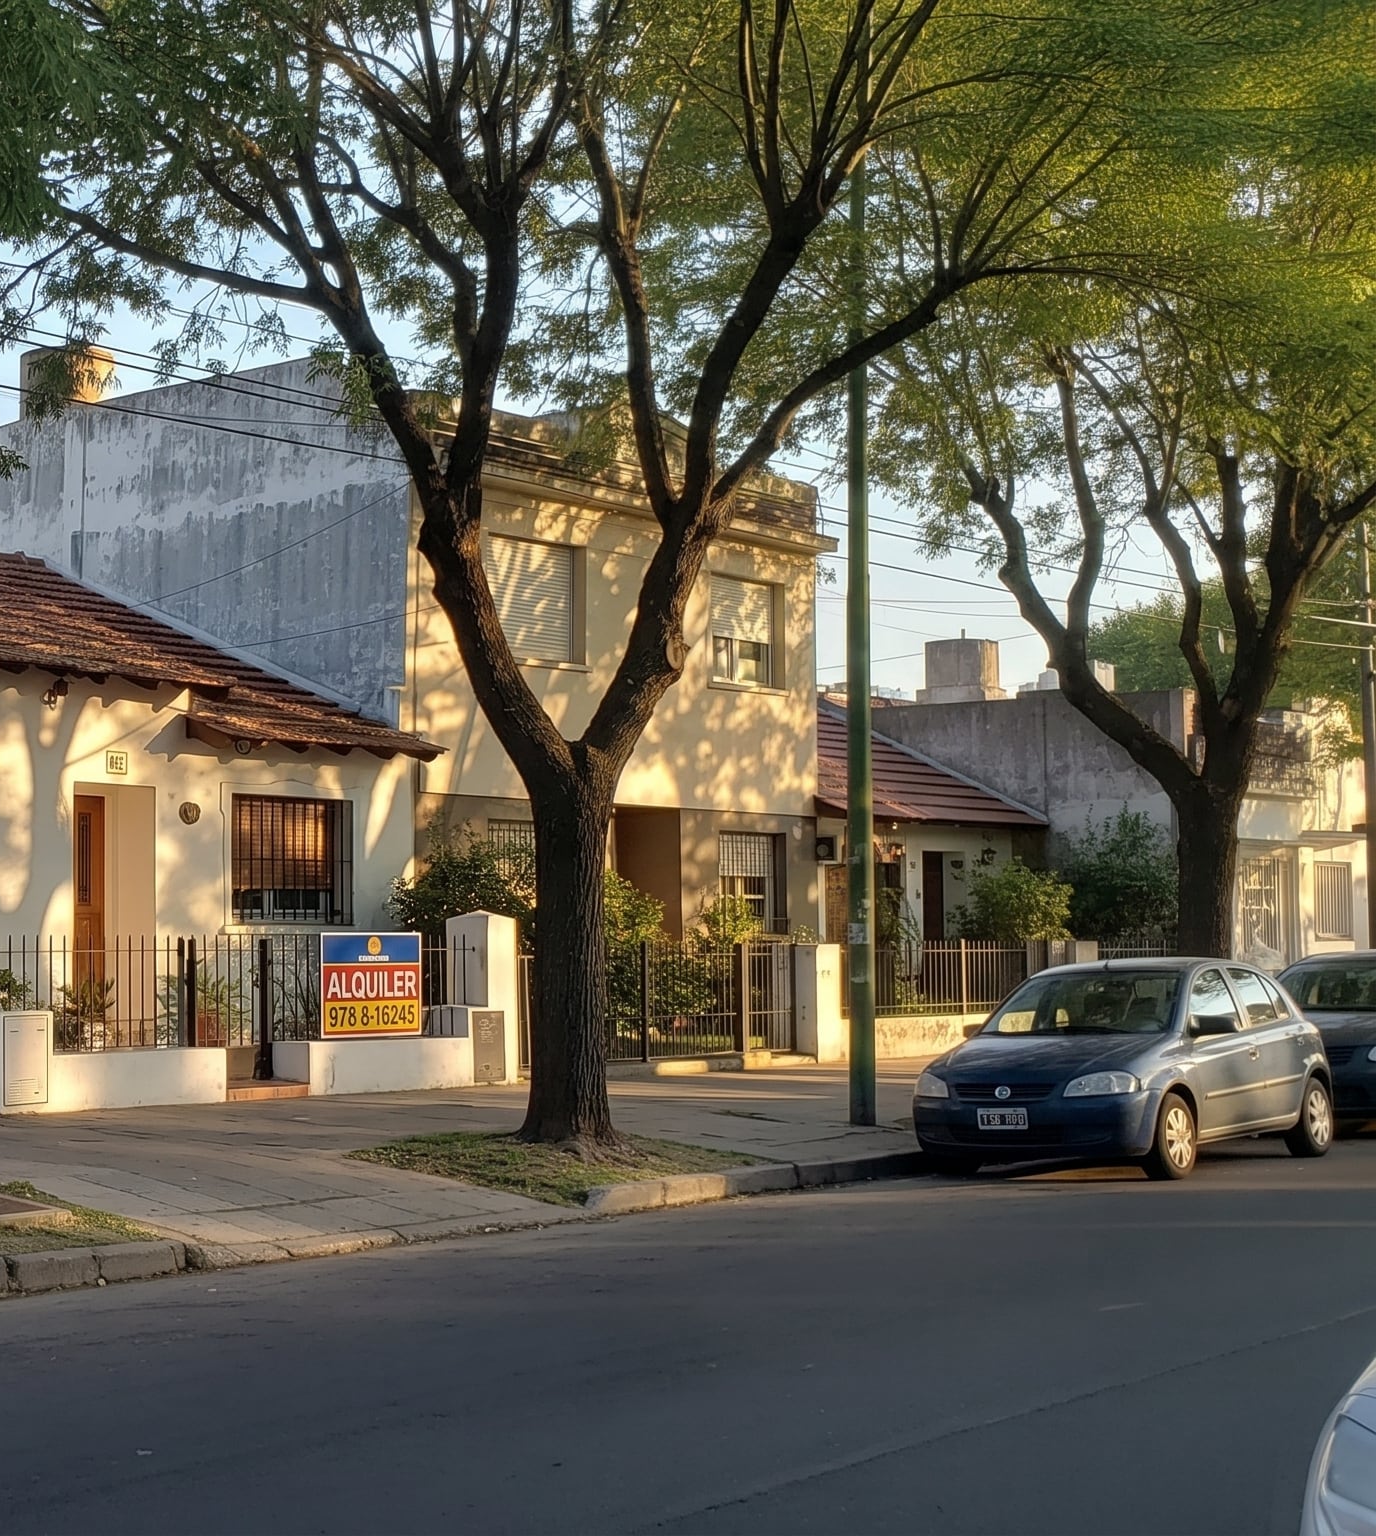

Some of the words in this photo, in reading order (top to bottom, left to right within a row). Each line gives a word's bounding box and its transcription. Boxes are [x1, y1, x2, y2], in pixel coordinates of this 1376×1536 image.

[326, 970, 417, 999] ALQUILER
[329, 1006, 357, 1027] 978
[360, 1004, 415, 1026] 8-16245
